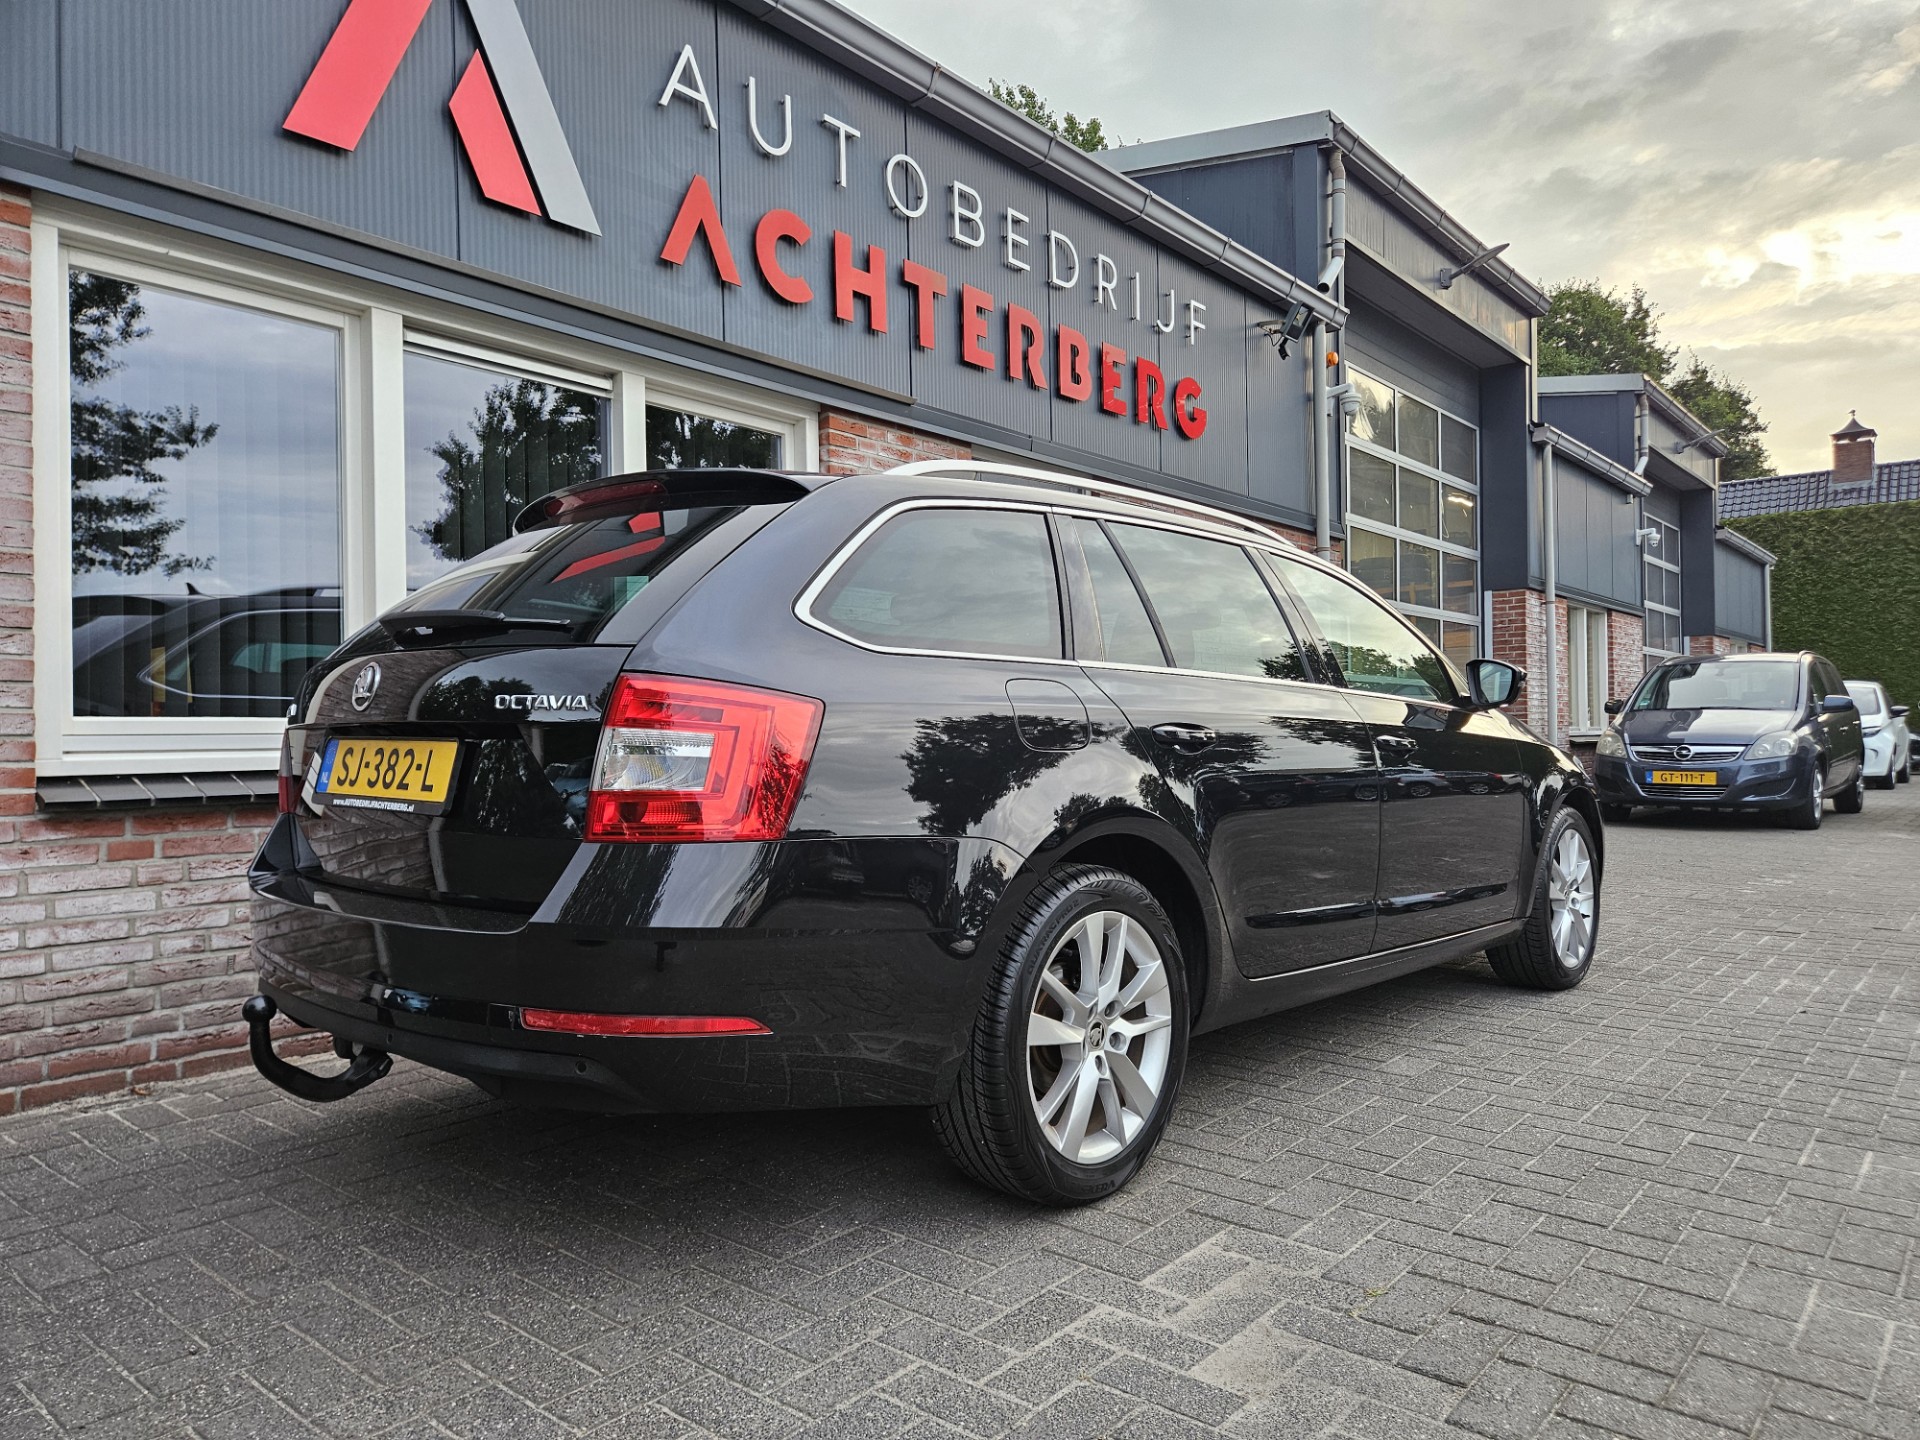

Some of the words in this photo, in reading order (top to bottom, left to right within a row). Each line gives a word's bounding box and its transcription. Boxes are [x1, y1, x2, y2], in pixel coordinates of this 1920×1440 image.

[658, 44, 1206, 345] AUTOBEDRIJF
[660, 174, 1207, 439] ACHTERBERG
[494, 694, 589, 711] OCTAVIA
[337, 746, 434, 792] SJ-382-L
[1660, 773, 1705, 783] GT-111-T
